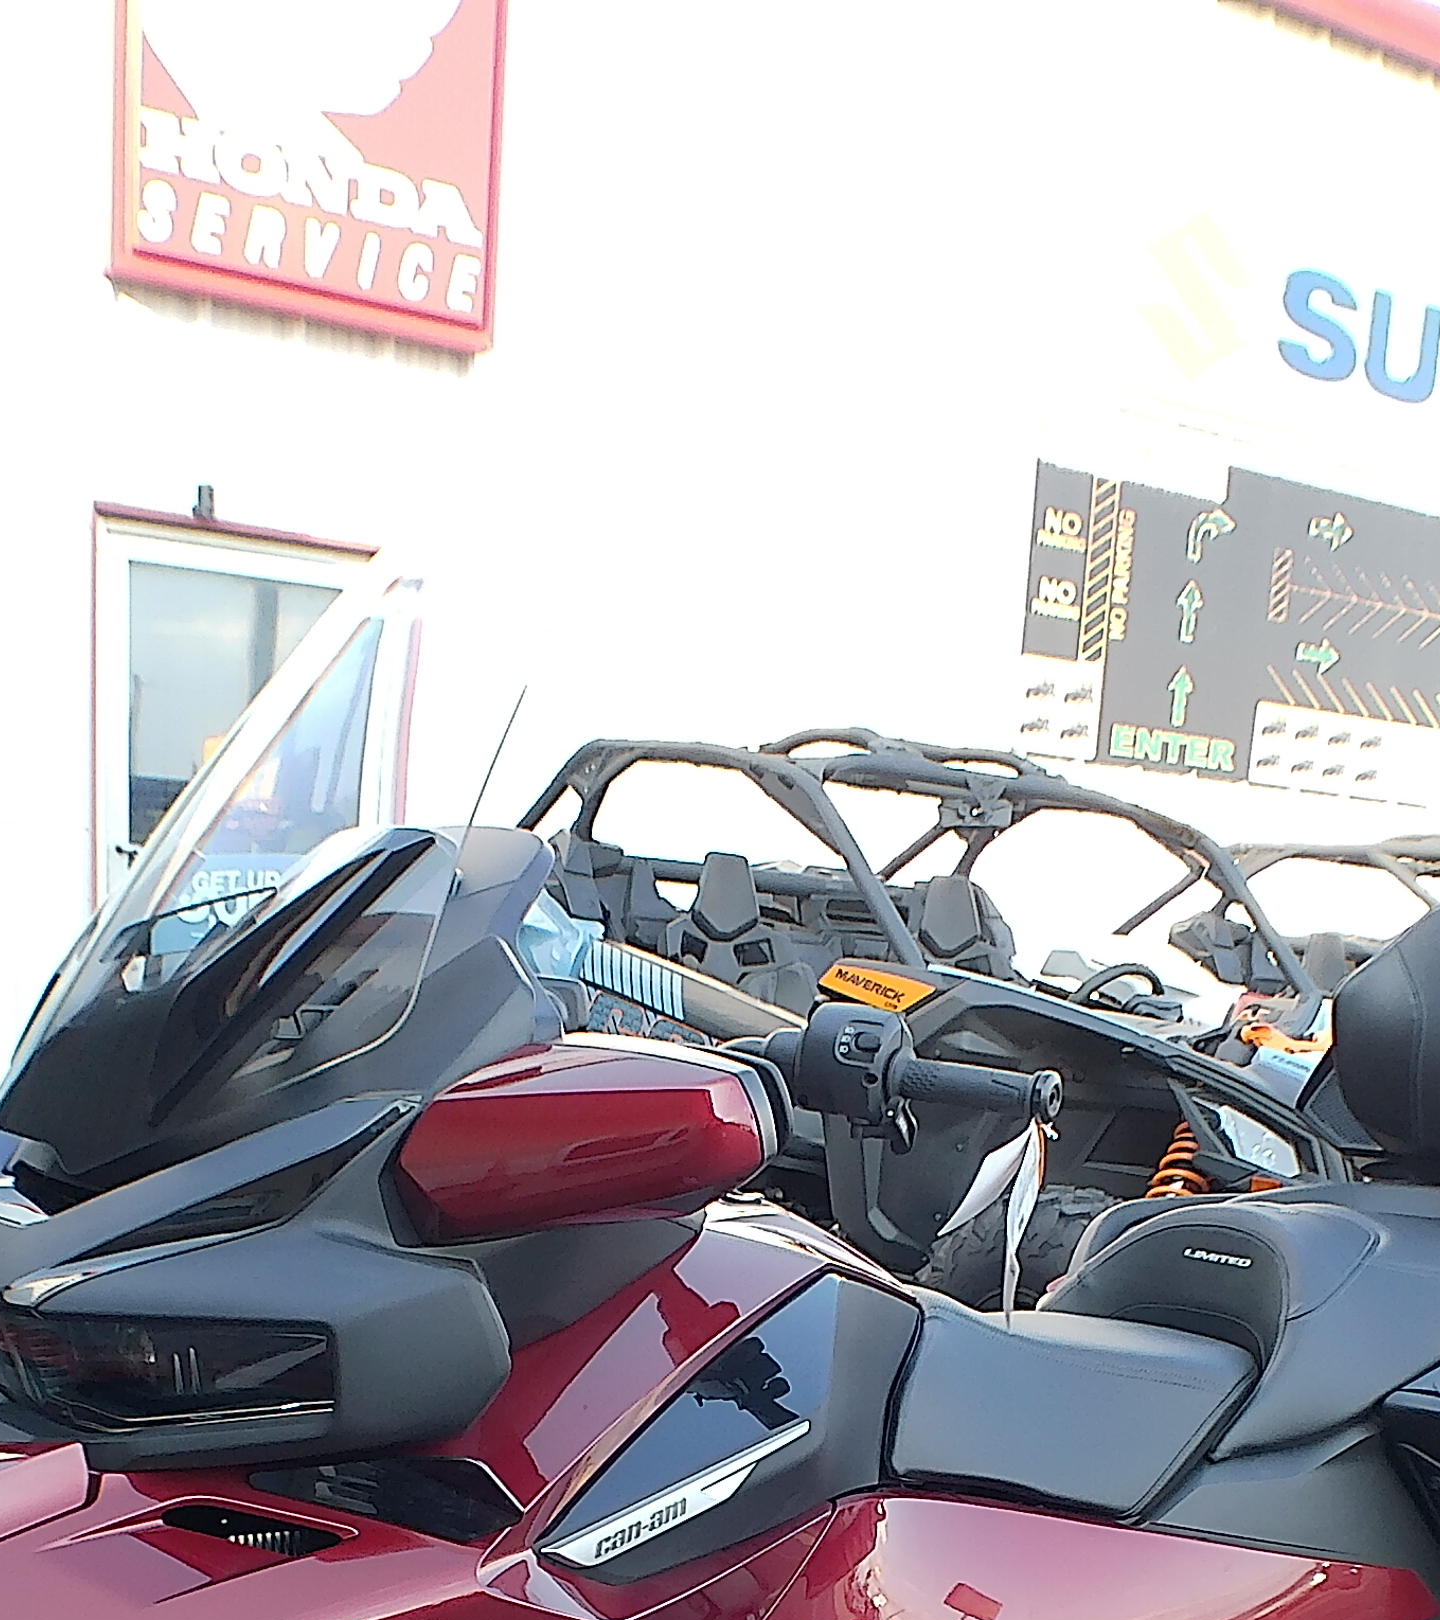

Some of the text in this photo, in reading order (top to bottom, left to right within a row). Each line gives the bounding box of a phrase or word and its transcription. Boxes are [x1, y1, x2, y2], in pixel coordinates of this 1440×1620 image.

[140, 105, 483, 249] HONDA
[137, 179, 483, 313] SERVICE
[1044, 507, 1082, 536] NO
[1039, 576, 1077, 605] NO
[1110, 722, 1236, 772] ENTER
[192, 869, 241, 892] GET
[834, 968, 905, 1003] MAVERICK
[1184, 1248, 1252, 1267] LIMITED
[595, 1497, 686, 1559] can-am
